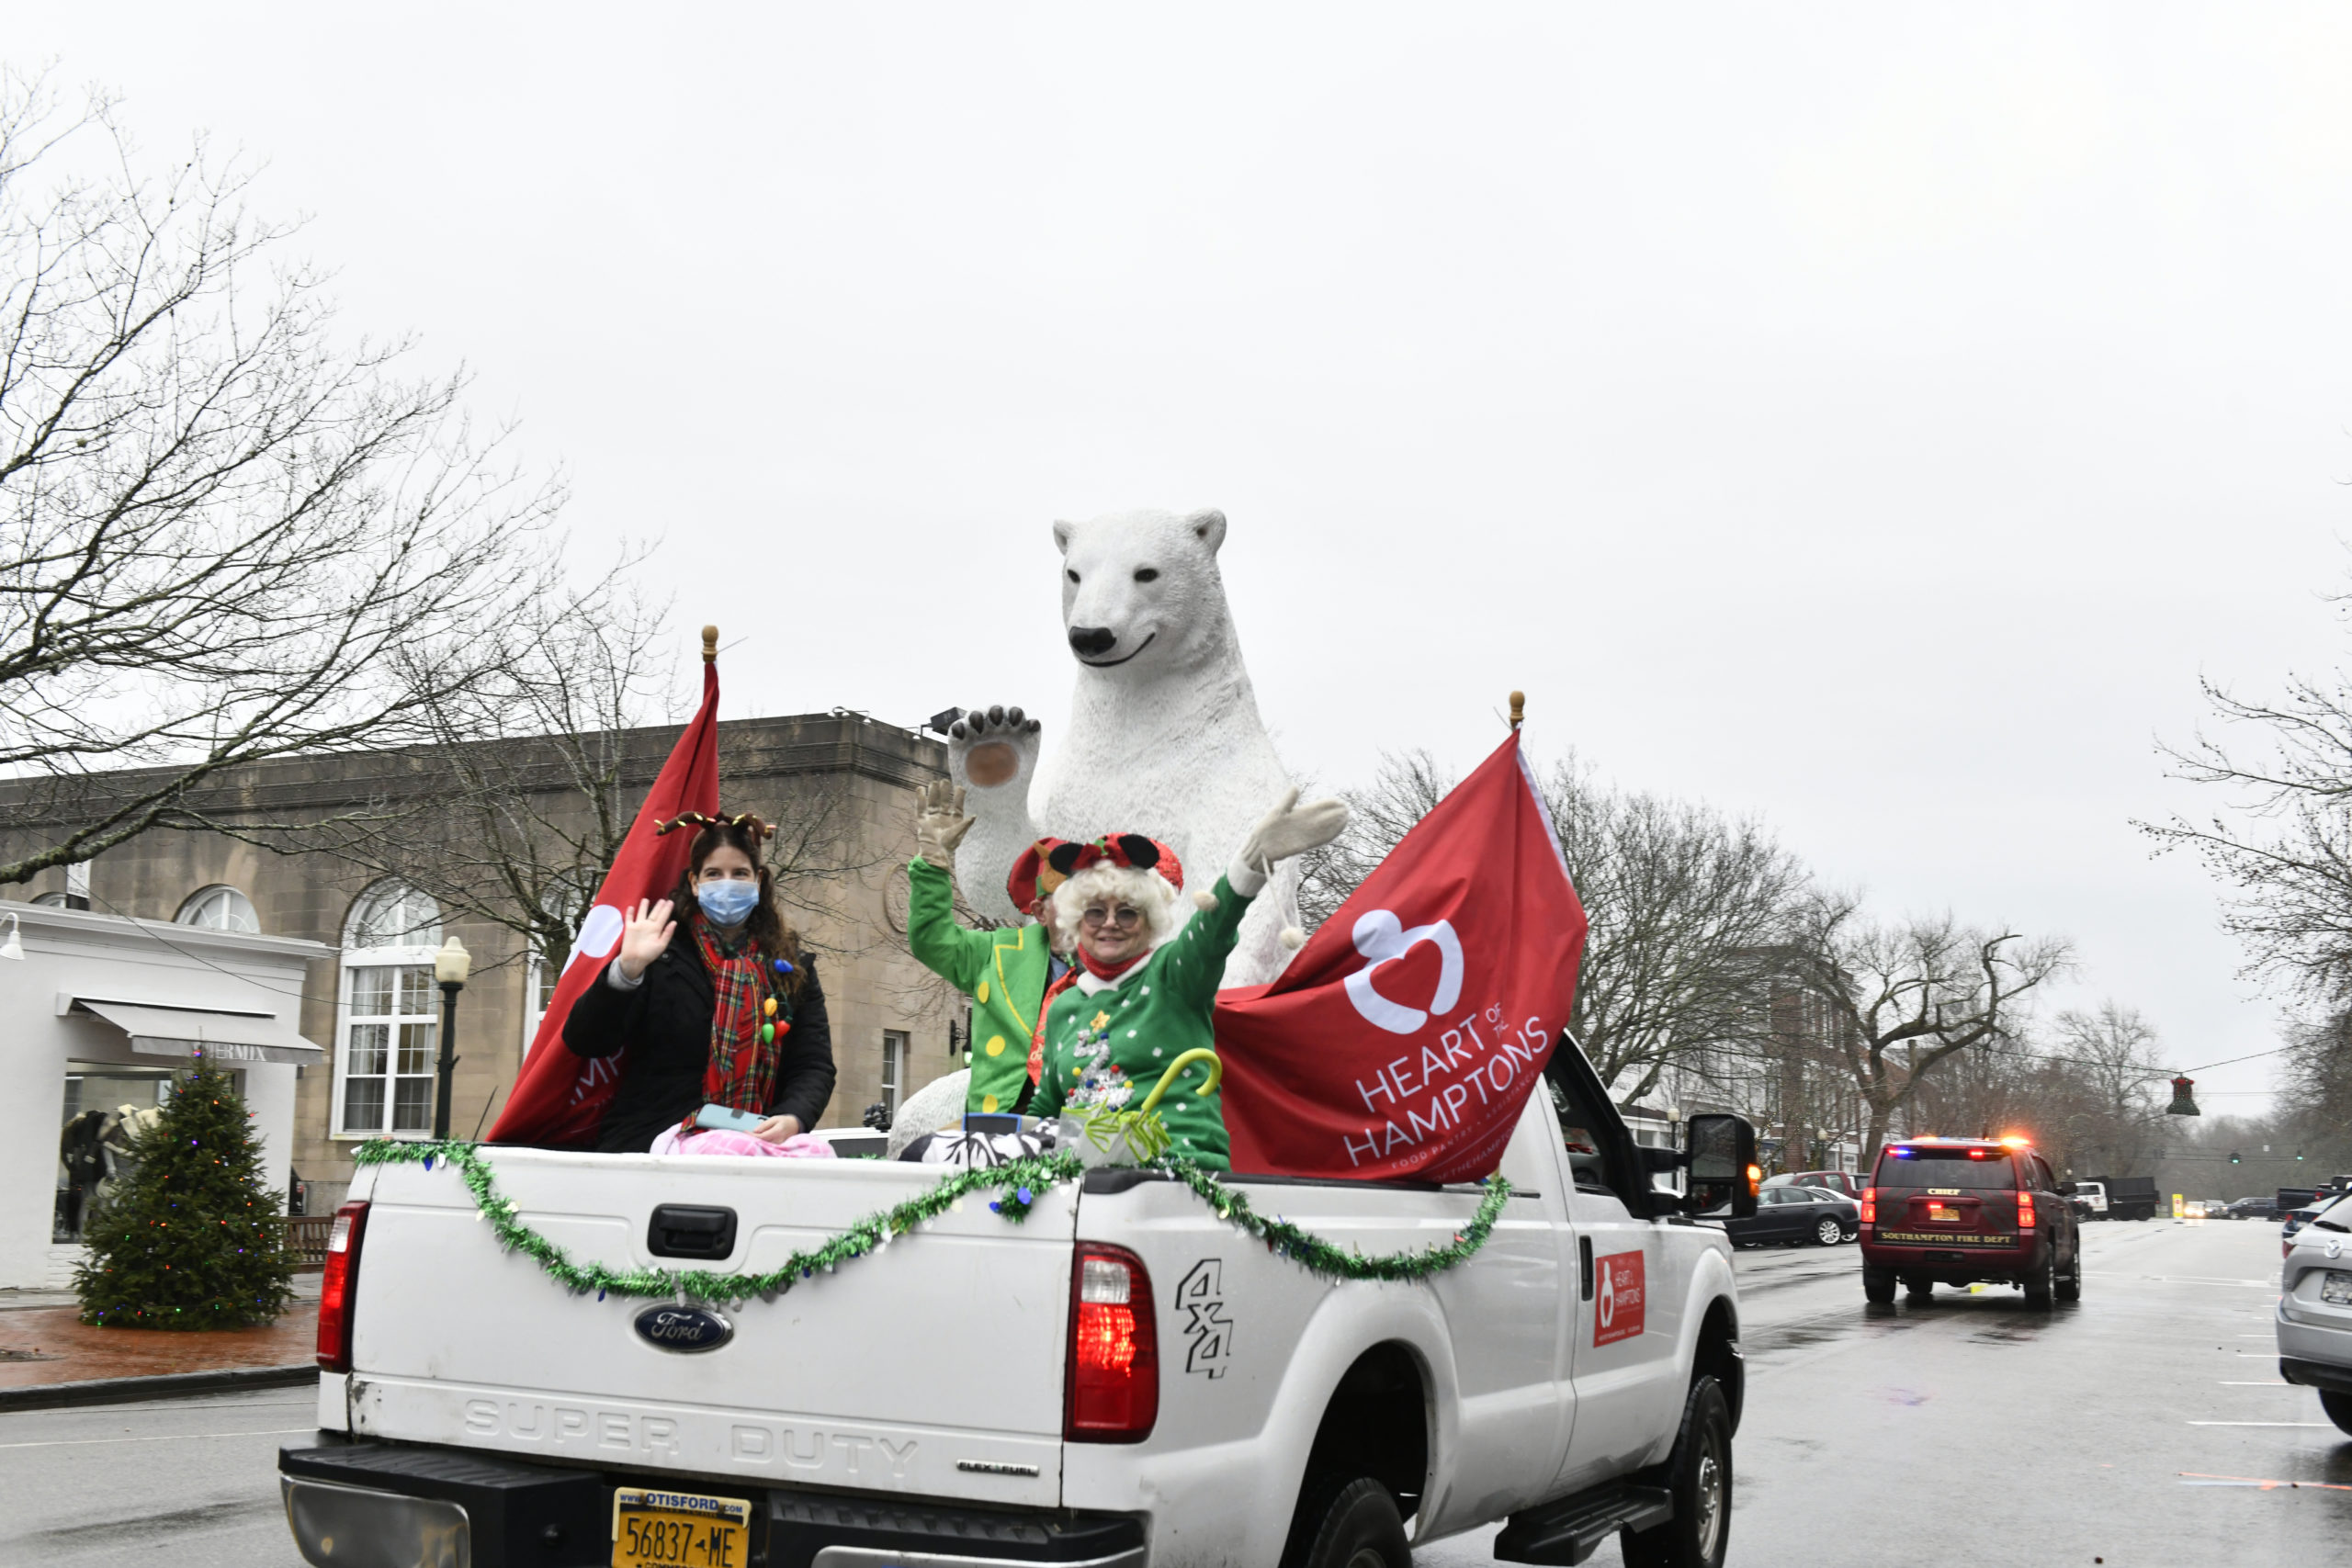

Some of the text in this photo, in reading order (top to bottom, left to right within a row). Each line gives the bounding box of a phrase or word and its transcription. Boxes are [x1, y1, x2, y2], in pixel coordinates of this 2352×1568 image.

[1355, 1013, 1485, 1113] HEART
[1342, 1016, 1548, 1168] HAMPTONS
[1391, 1151, 1428, 1169] FOOD
[1431, 1126, 1472, 1155] PANTRY
[1927, 1188, 1962, 1196] CHIEF
[1881, 1232, 2011, 1244] SOUTHAMPTON FIRE DEPT
[650, 1312, 705, 1341] Ford
[464, 1398, 920, 1478] SUPER DUTY
[627, 1517, 736, 1568] 56837 ME
